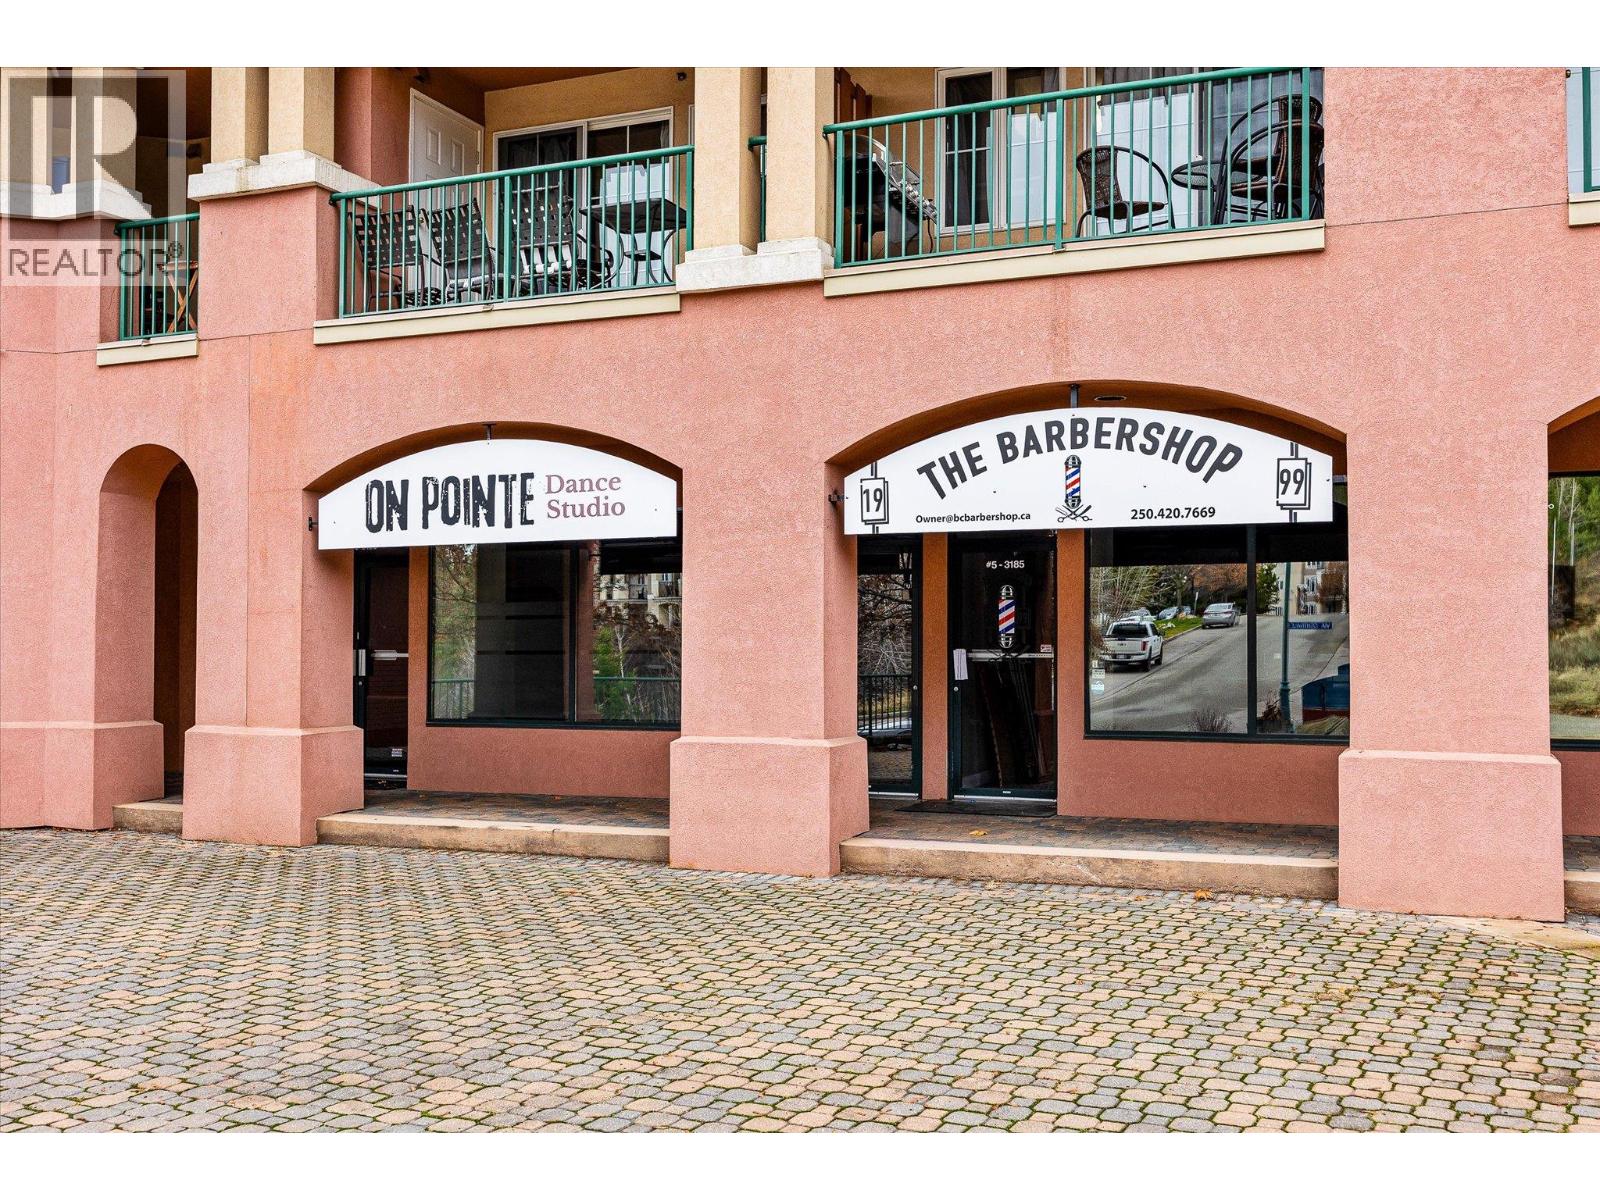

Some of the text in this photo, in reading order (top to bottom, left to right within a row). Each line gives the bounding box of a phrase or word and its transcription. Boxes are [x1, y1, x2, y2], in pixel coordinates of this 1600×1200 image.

[916, 416, 1243, 500] THE BARBERSHOP
[545, 473, 622, 495] Dance
[1279, 468, 1305, 496] 99
[365, 472, 535, 533] ON POINTE
[546, 496, 626, 520] Studio
[862, 488, 883, 513] 19
[915, 512, 1031, 524] Owner@bcbarbershop.ca
[1130, 506, 1216, 520] 250.420.7669
[985, 560, 998, 570] #5
[1004, 560, 1025, 569] 3185
